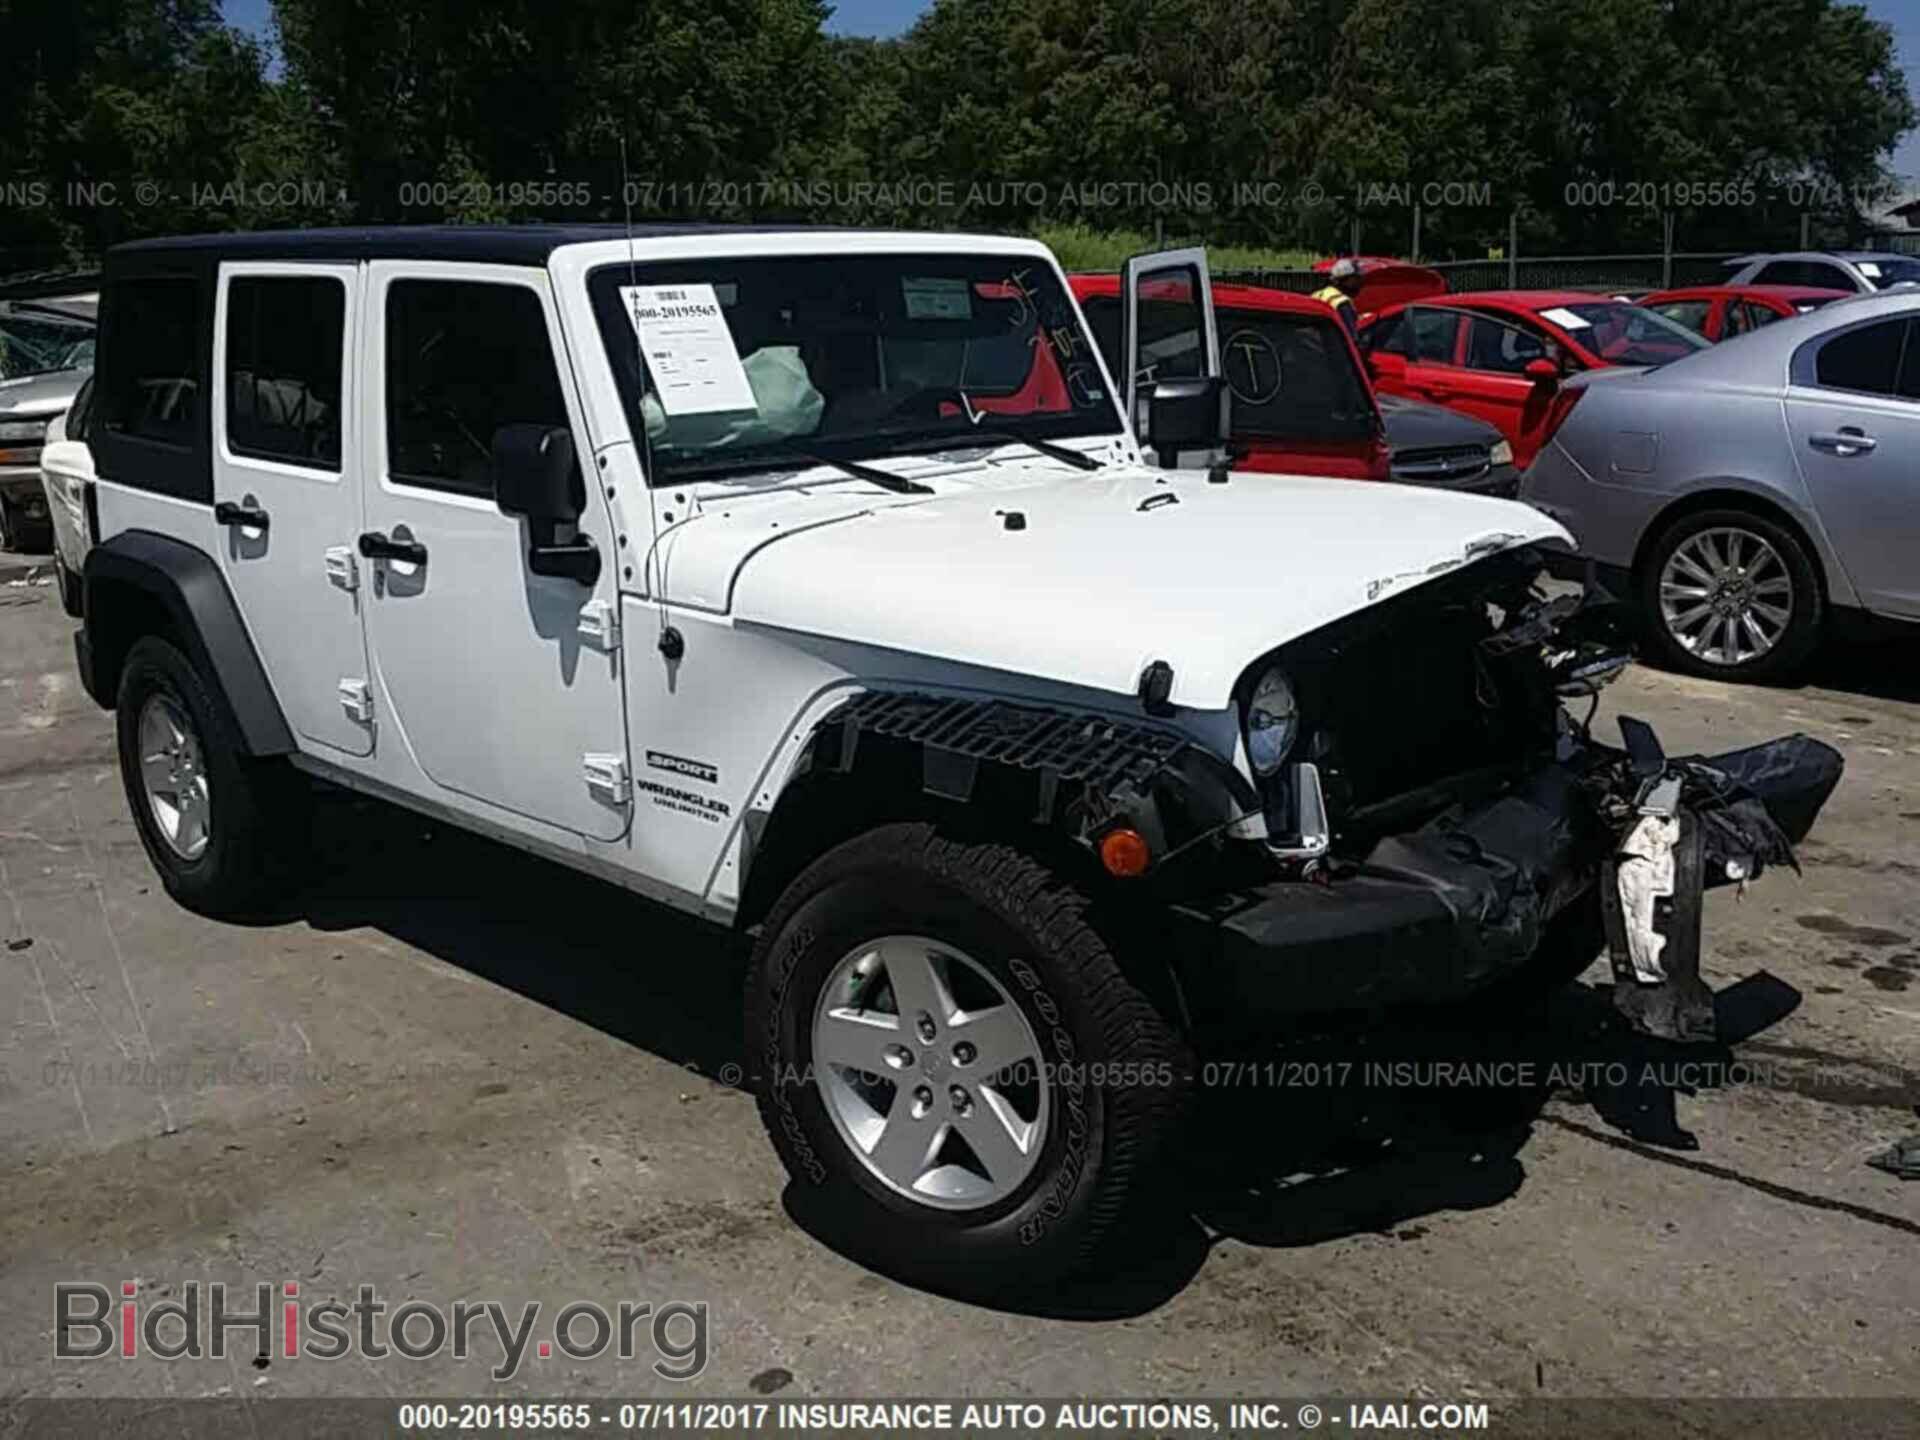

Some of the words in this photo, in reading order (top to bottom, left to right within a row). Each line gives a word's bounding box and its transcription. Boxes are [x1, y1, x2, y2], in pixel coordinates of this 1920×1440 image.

[647, 753, 718, 780] SPORT
[638, 779, 731, 817] WRANGLER
[1008, 959, 1088, 1245] GOODYEAR
